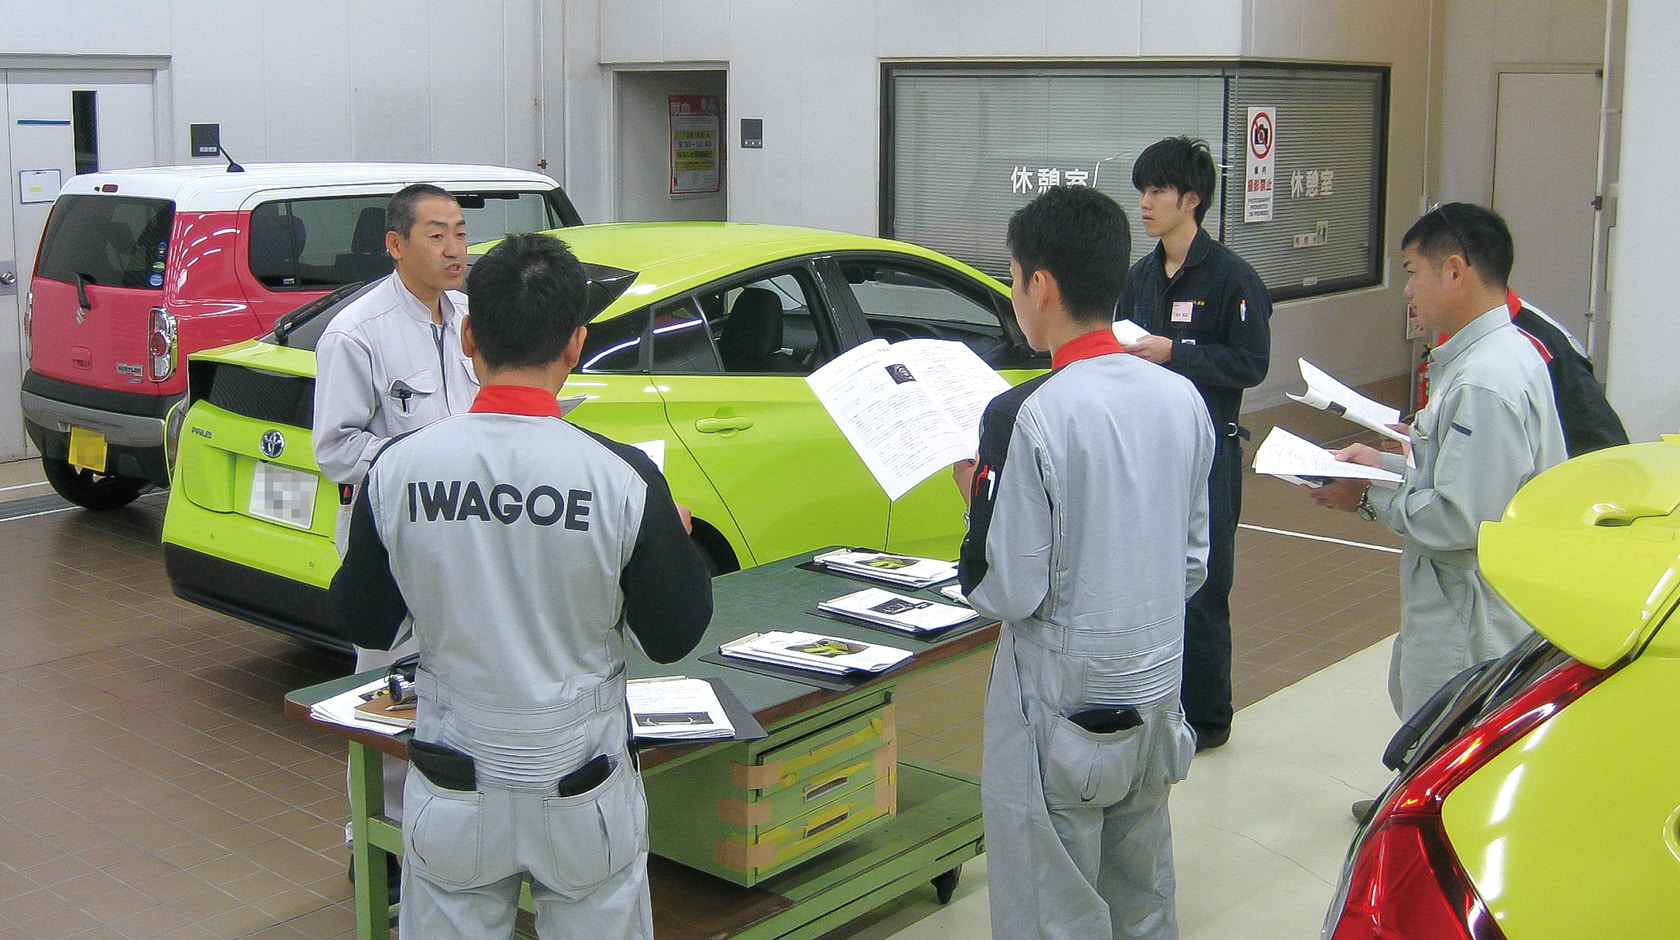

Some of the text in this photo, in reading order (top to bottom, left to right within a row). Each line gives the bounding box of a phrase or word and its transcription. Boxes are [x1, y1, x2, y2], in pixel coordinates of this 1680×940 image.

[1010, 166, 1089, 195] 休憩室
[1290, 168, 1335, 199] 休憩室
[407, 480, 593, 532] IWAGOE
